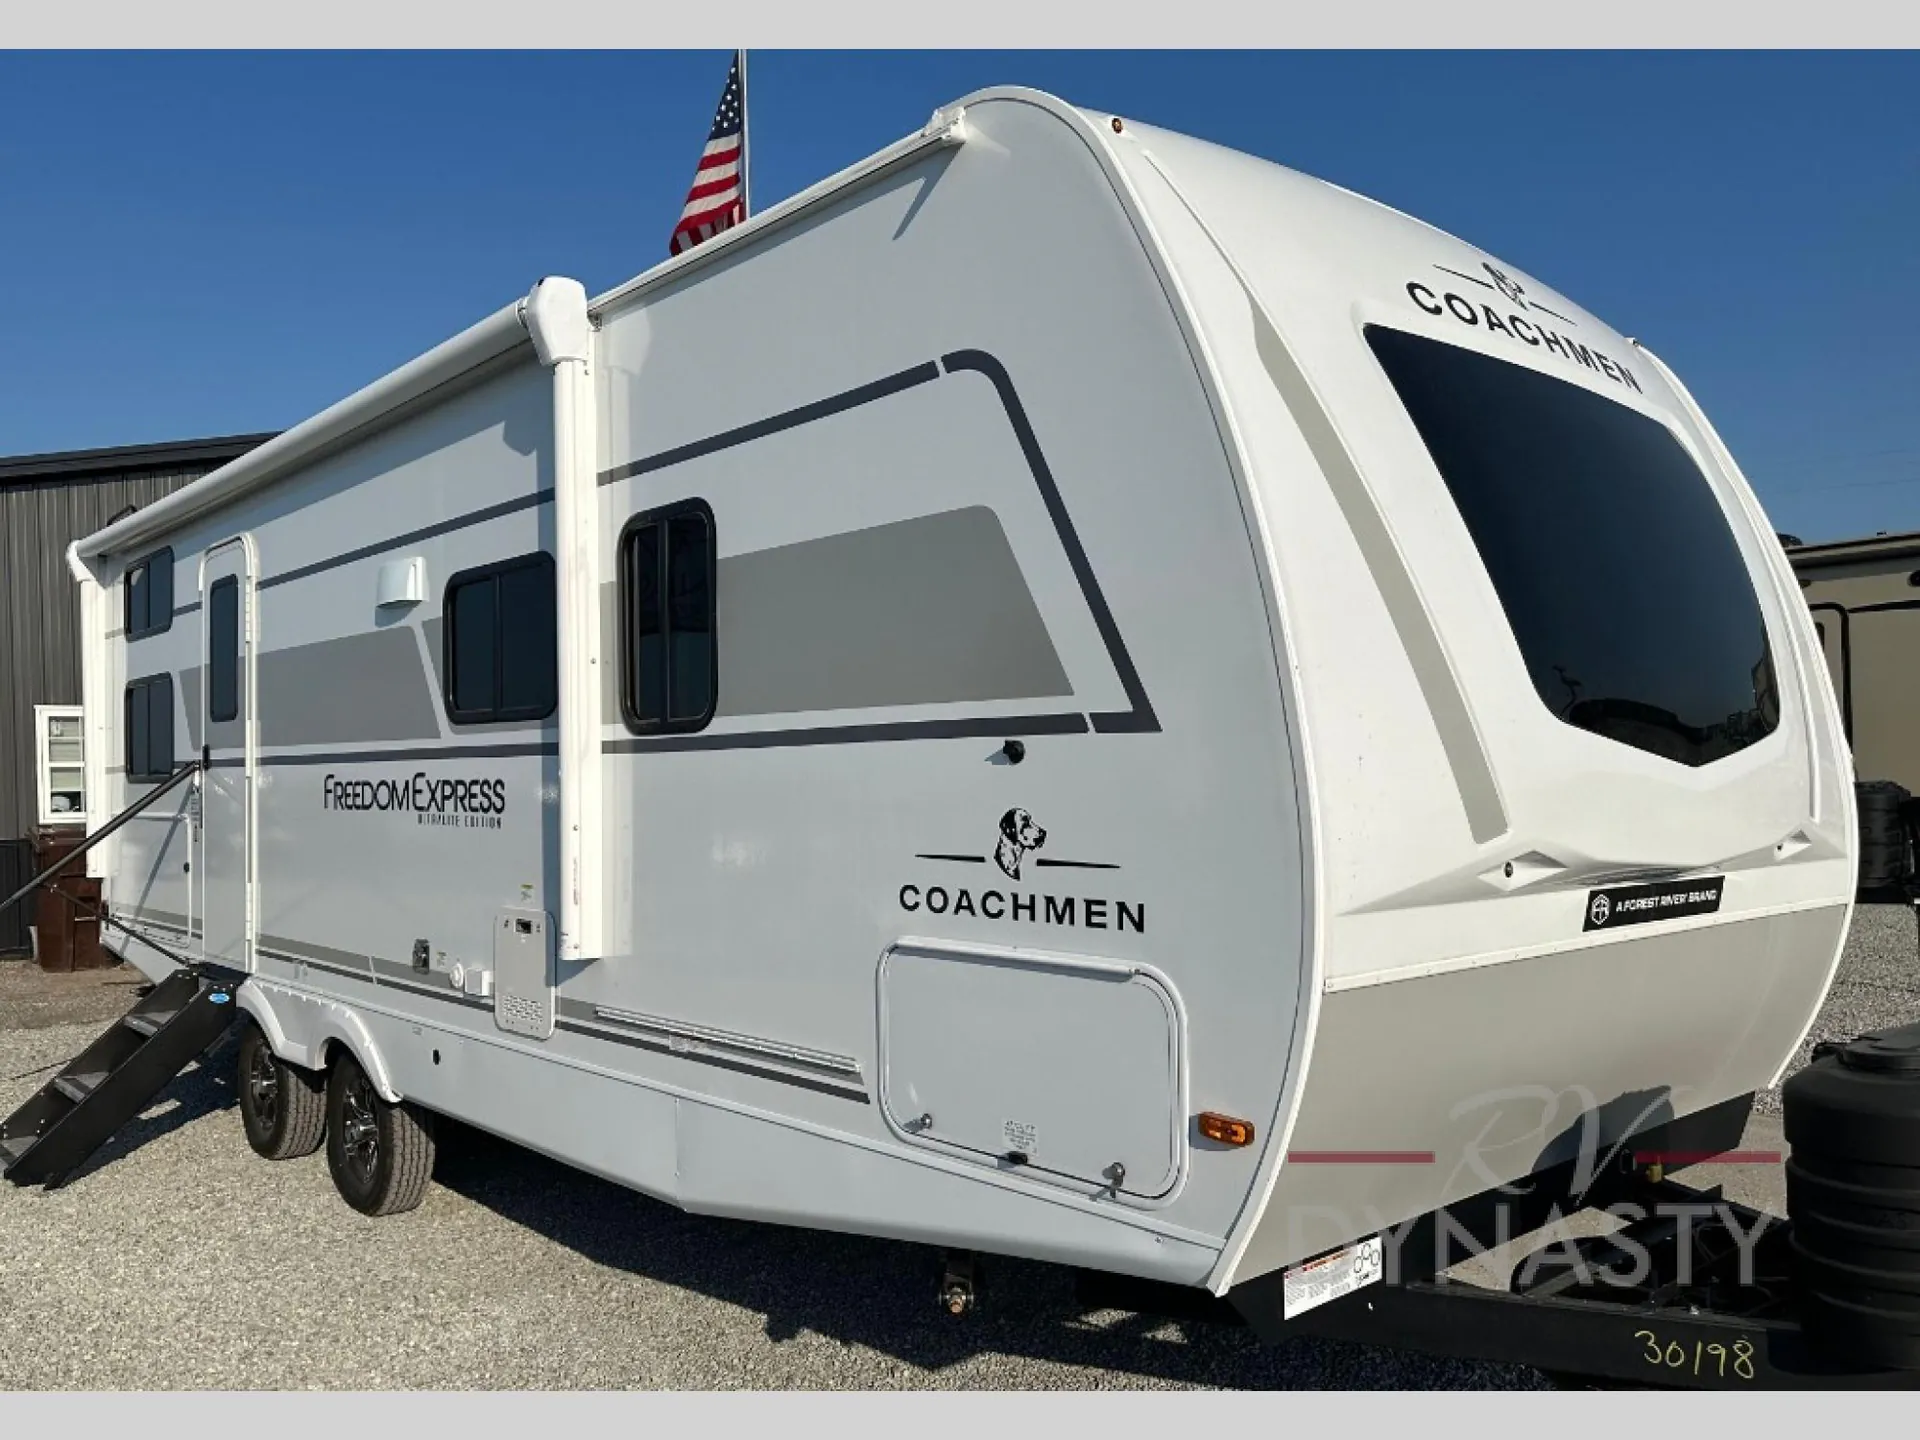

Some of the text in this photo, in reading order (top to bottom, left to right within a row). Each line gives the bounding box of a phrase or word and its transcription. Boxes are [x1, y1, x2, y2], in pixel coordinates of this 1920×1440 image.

[1406, 281, 1643, 395] COACHMEN
[899, 884, 1145, 933] COACHMEN
[1623, 896, 1659, 911] FOREST
[1688, 889, 1718, 903] BRAND
[1634, 1329, 1755, 1379] 30198
